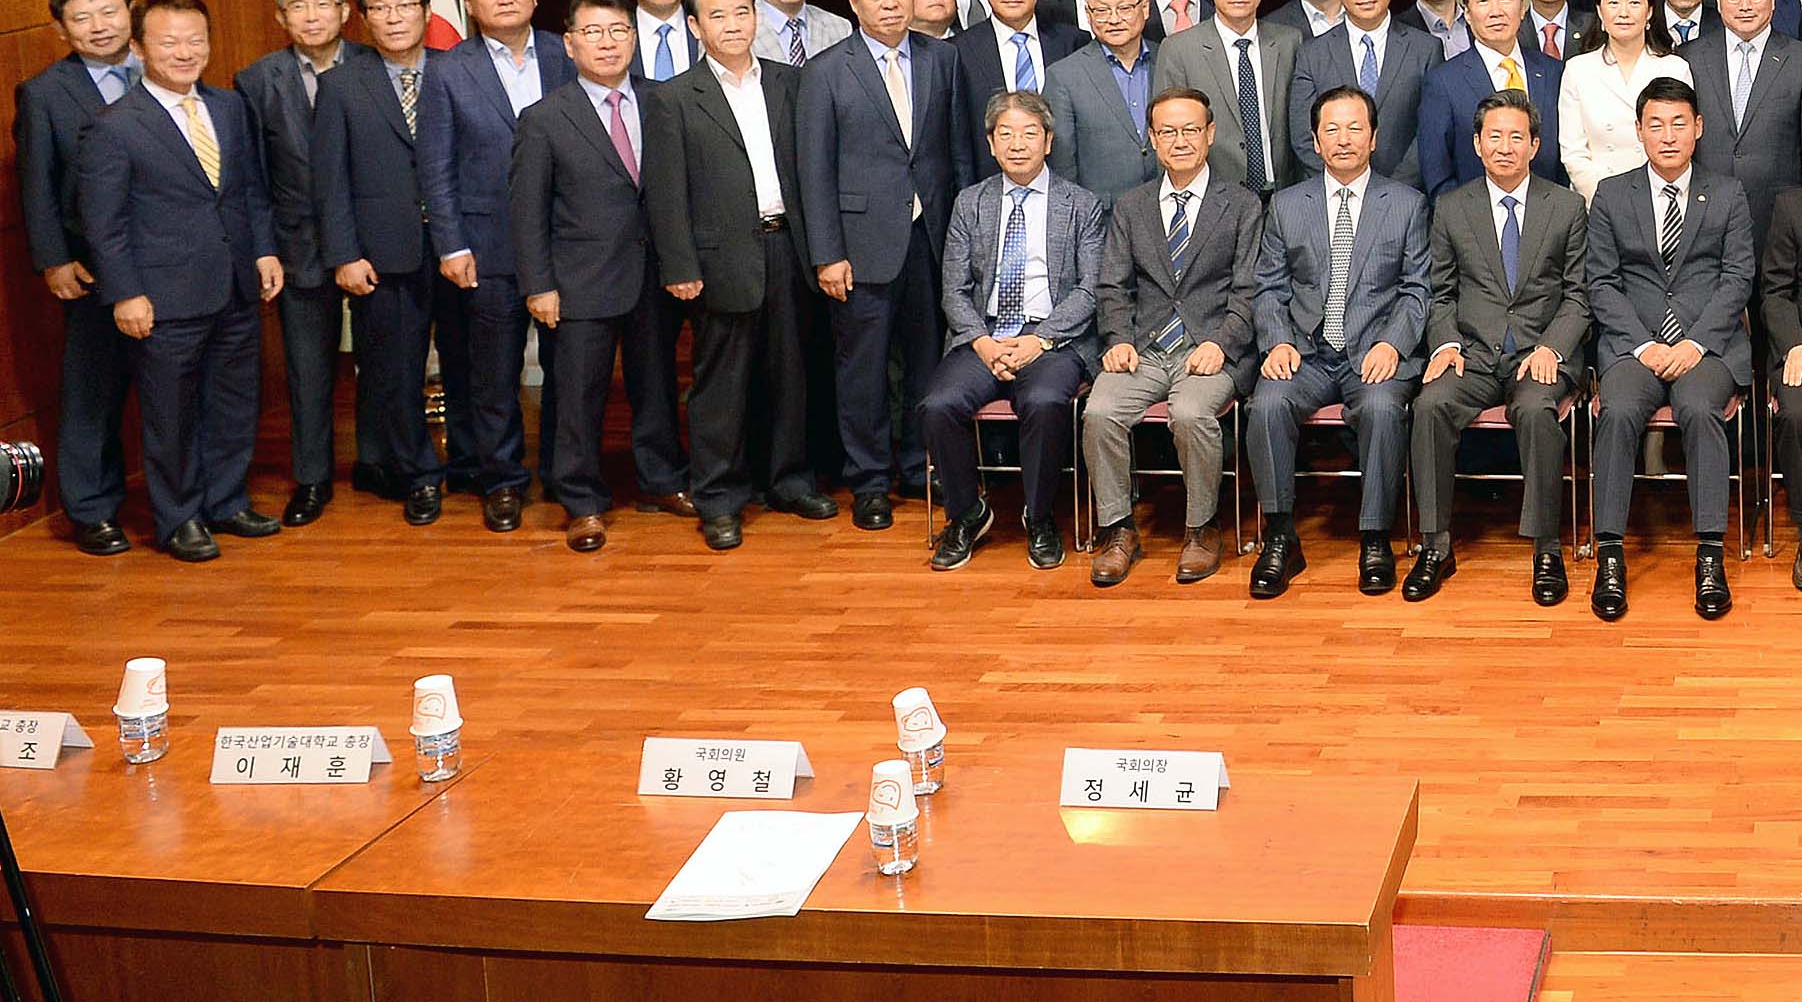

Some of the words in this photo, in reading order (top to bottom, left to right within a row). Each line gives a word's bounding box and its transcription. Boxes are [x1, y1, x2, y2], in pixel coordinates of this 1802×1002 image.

[220, 735, 338, 749] 한국산업기술대학교
[17, 742, 38, 760] 조
[695, 747, 746, 762] 국회의원
[1116, 758, 1168, 774] 국회의장
